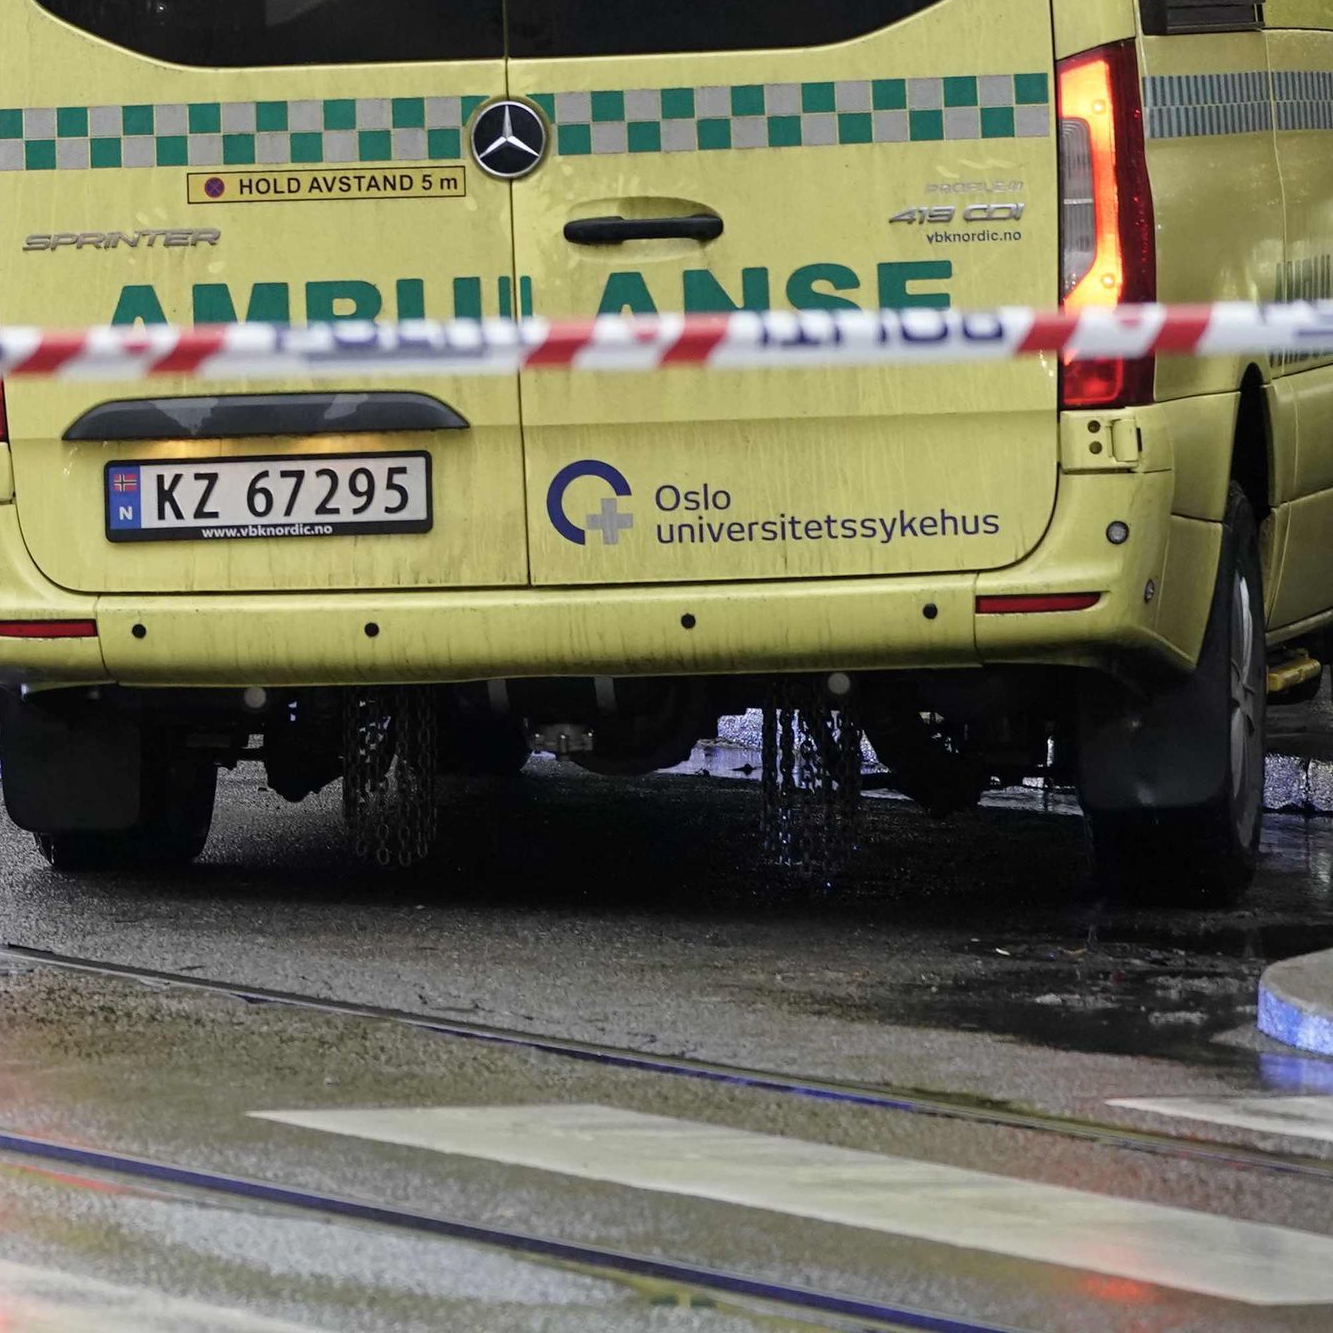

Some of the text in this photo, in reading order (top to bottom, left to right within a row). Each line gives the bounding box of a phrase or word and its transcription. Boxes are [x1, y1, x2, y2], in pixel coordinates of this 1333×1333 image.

[238, 172, 459, 196] HOLD AVSTAND 5 m
[889, 202, 1026, 225] 419 CDI
[22, 228, 222, 251] SPRINTER
[926, 229, 1023, 244] vbknordic.no
[156, 466, 410, 521] KZ 67295
[655, 483, 732, 512] Oslo
[119, 506, 133, 521] N
[201, 522, 334, 539] www.vbknordic.no
[656, 508, 1001, 545] universitetssykehus
